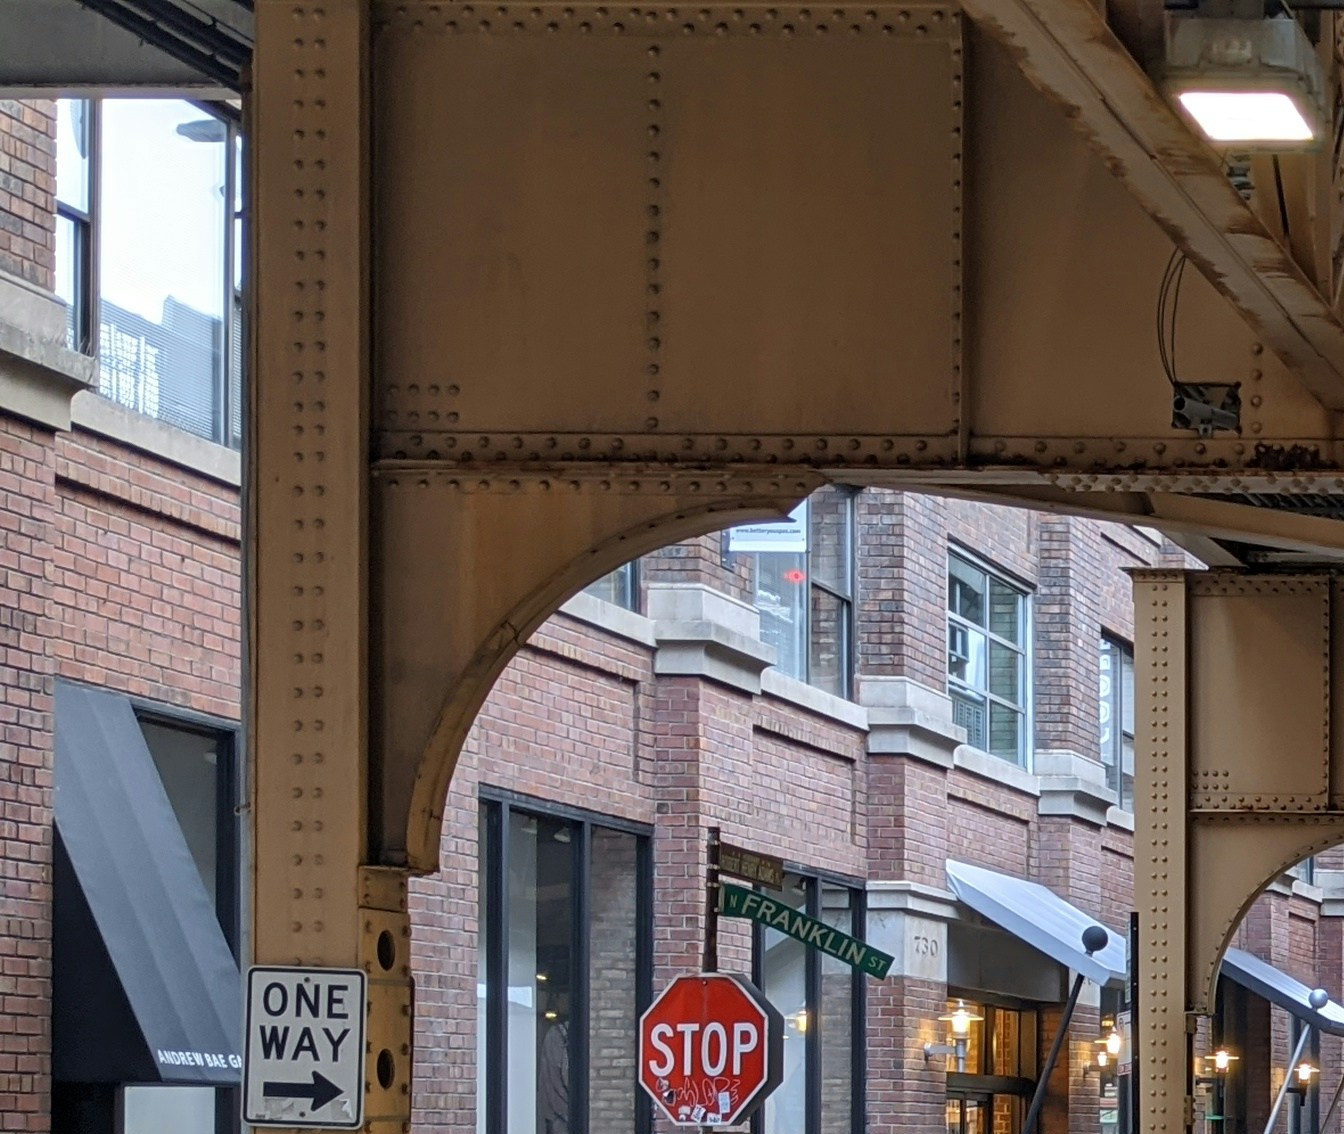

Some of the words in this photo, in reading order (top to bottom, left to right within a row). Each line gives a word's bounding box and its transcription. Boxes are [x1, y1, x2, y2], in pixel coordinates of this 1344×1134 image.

[729, 893, 737, 908] N
[741, 893, 867, 966] FRANKLIN
[867, 955, 887, 971] ST
[913, 935, 939, 958] 730
[263, 982, 349, 1020] ONE
[157, 1049, 205, 1067] ANDREW
[204, 1053, 228, 1069] BAE
[259, 1024, 351, 1063] WAY
[648, 1021, 759, 1077] STOP
